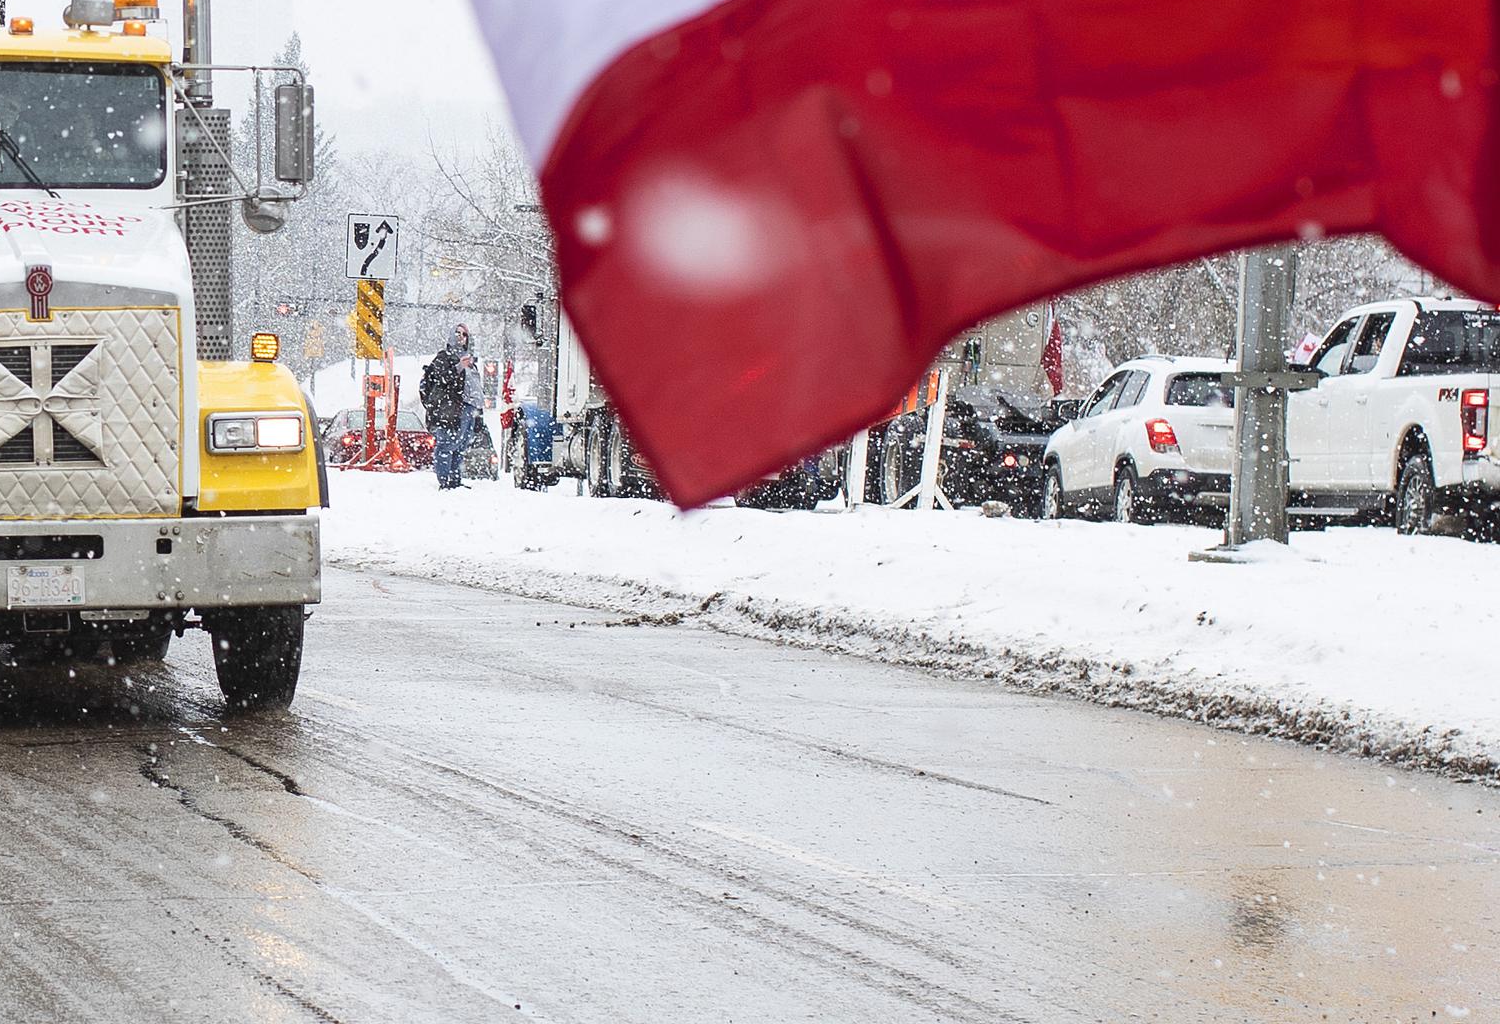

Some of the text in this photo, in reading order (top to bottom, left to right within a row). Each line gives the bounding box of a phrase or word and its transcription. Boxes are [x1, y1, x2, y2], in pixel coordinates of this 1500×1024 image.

[15, 199, 90, 208] YOU
[2, 207, 142, 223] WORLD
[15, 213, 123, 227] YOUR
